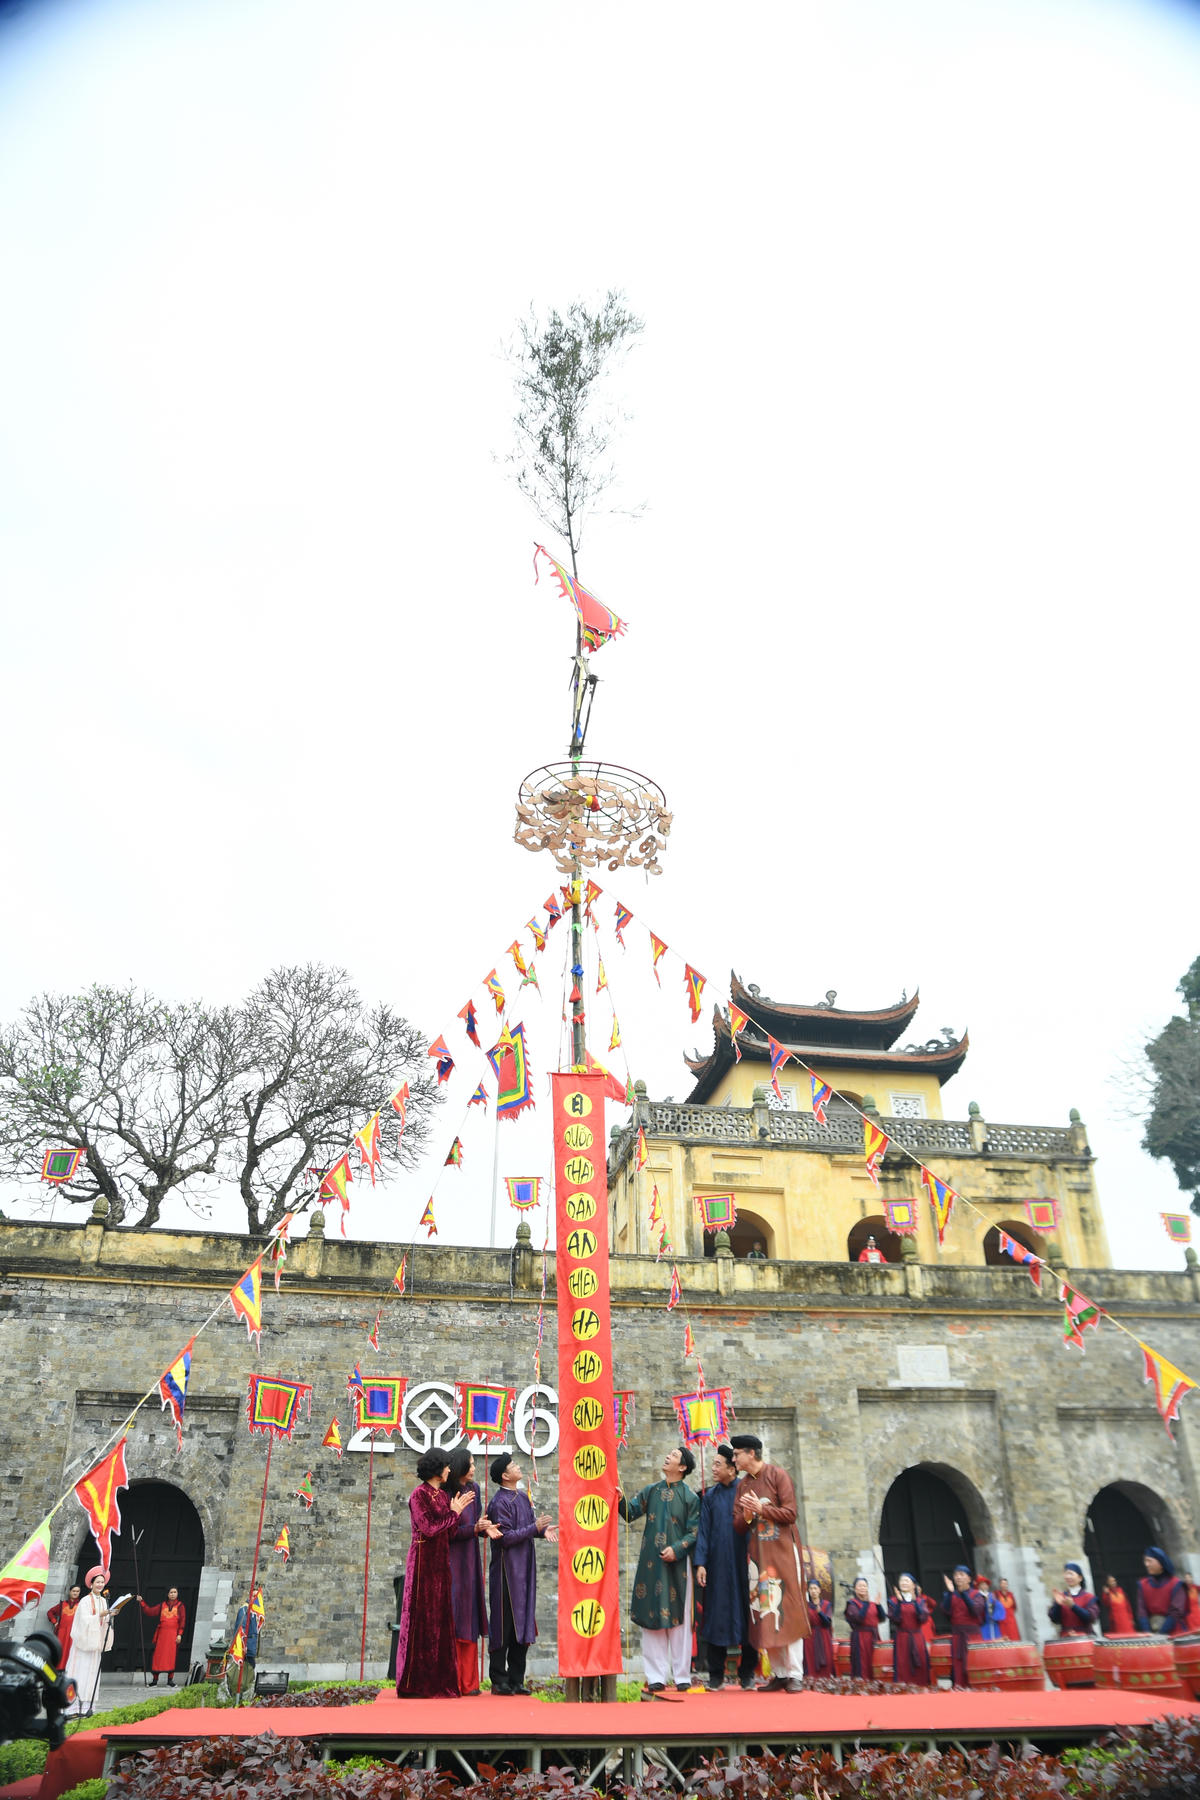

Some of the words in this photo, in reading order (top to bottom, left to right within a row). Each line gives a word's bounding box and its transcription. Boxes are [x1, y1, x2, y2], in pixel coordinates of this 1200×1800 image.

[568, 1193, 596, 1219] DÂN
[567, 1231, 597, 1257] AN
[569, 1269, 597, 1298] THIÊN
[572, 1310, 599, 1339] HẠ
[574, 1352, 602, 1383] THÁI
[574, 1399, 604, 1429] BÌNH
[574, 1446, 606, 1480] THÁNH
[574, 1497, 609, 1526] CUNG
[573, 1548, 606, 1583] VẠN
